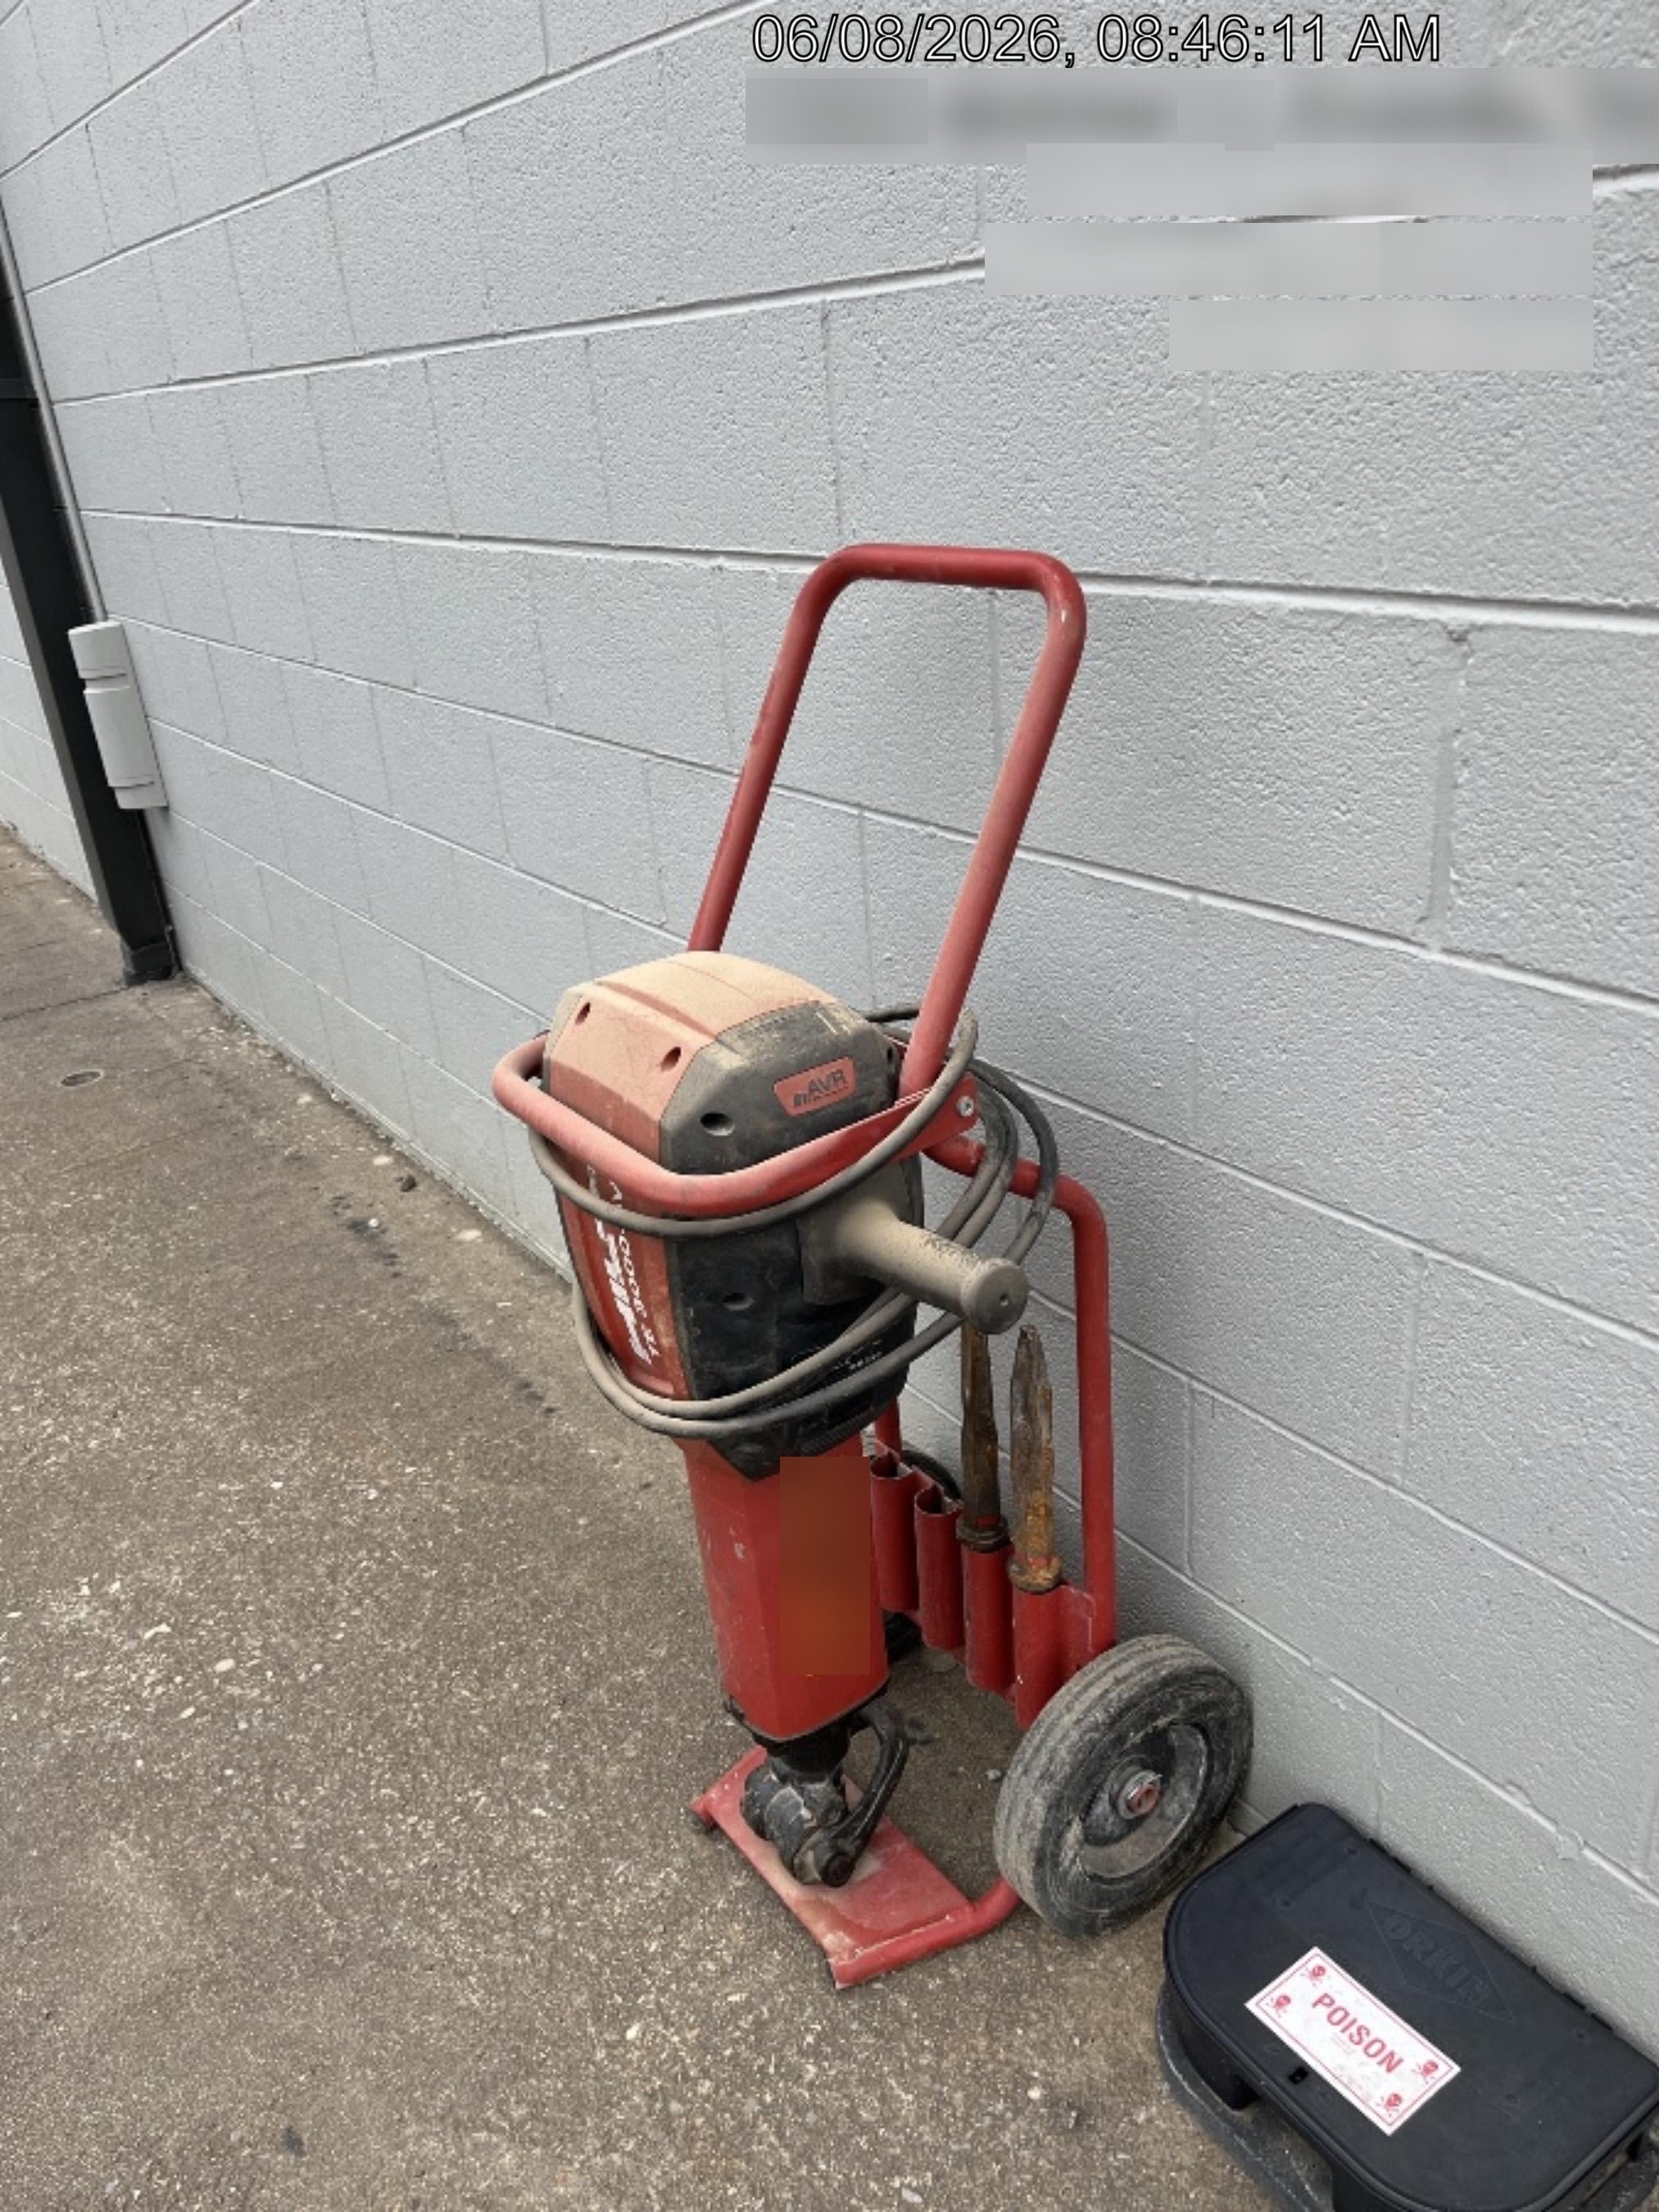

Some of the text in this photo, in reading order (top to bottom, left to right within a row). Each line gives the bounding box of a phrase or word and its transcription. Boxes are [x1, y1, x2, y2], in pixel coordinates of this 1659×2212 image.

[808, 1068, 849, 1095] AVR
[1384, 1915, 1494, 2007] ORKIN
[1312, 1992, 1405, 2074] POISON
